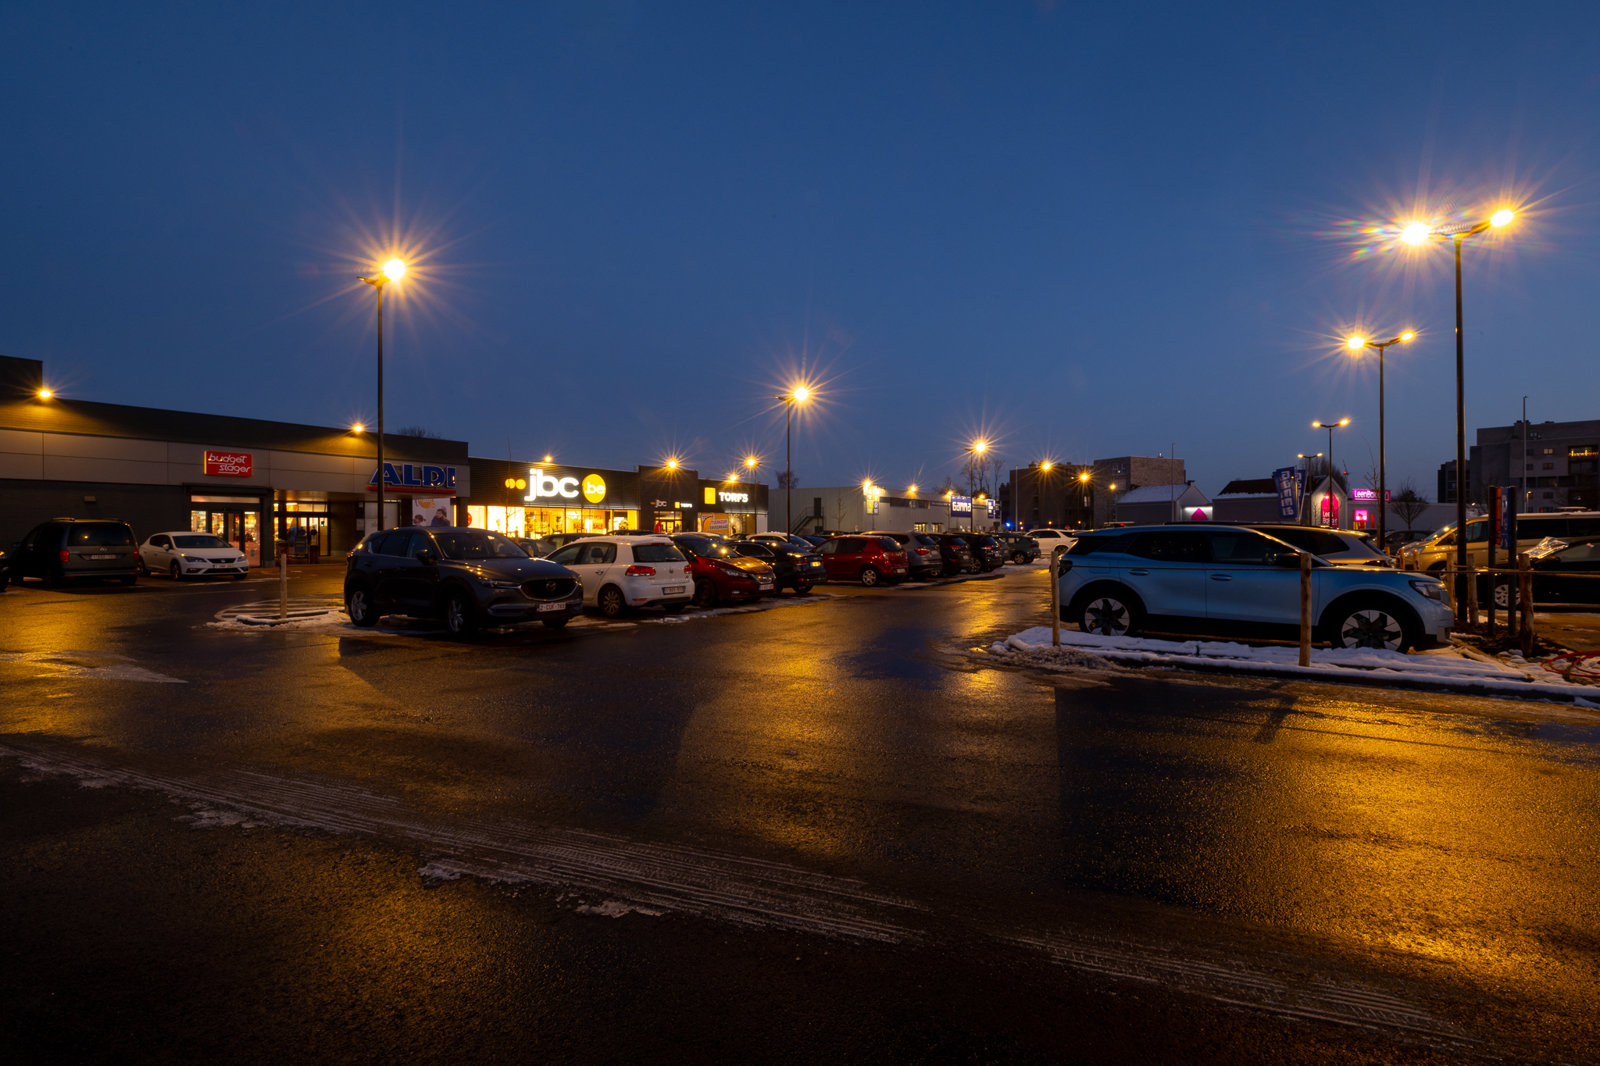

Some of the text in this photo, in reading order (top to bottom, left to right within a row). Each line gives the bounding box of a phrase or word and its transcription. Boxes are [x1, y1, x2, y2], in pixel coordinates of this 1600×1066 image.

[208, 453, 247, 465] budget
[218, 464, 251, 475] slager
[369, 462, 456, 488] ALDI
[523, 468, 579, 501] jbc
[719, 492, 749, 503] TORFS
